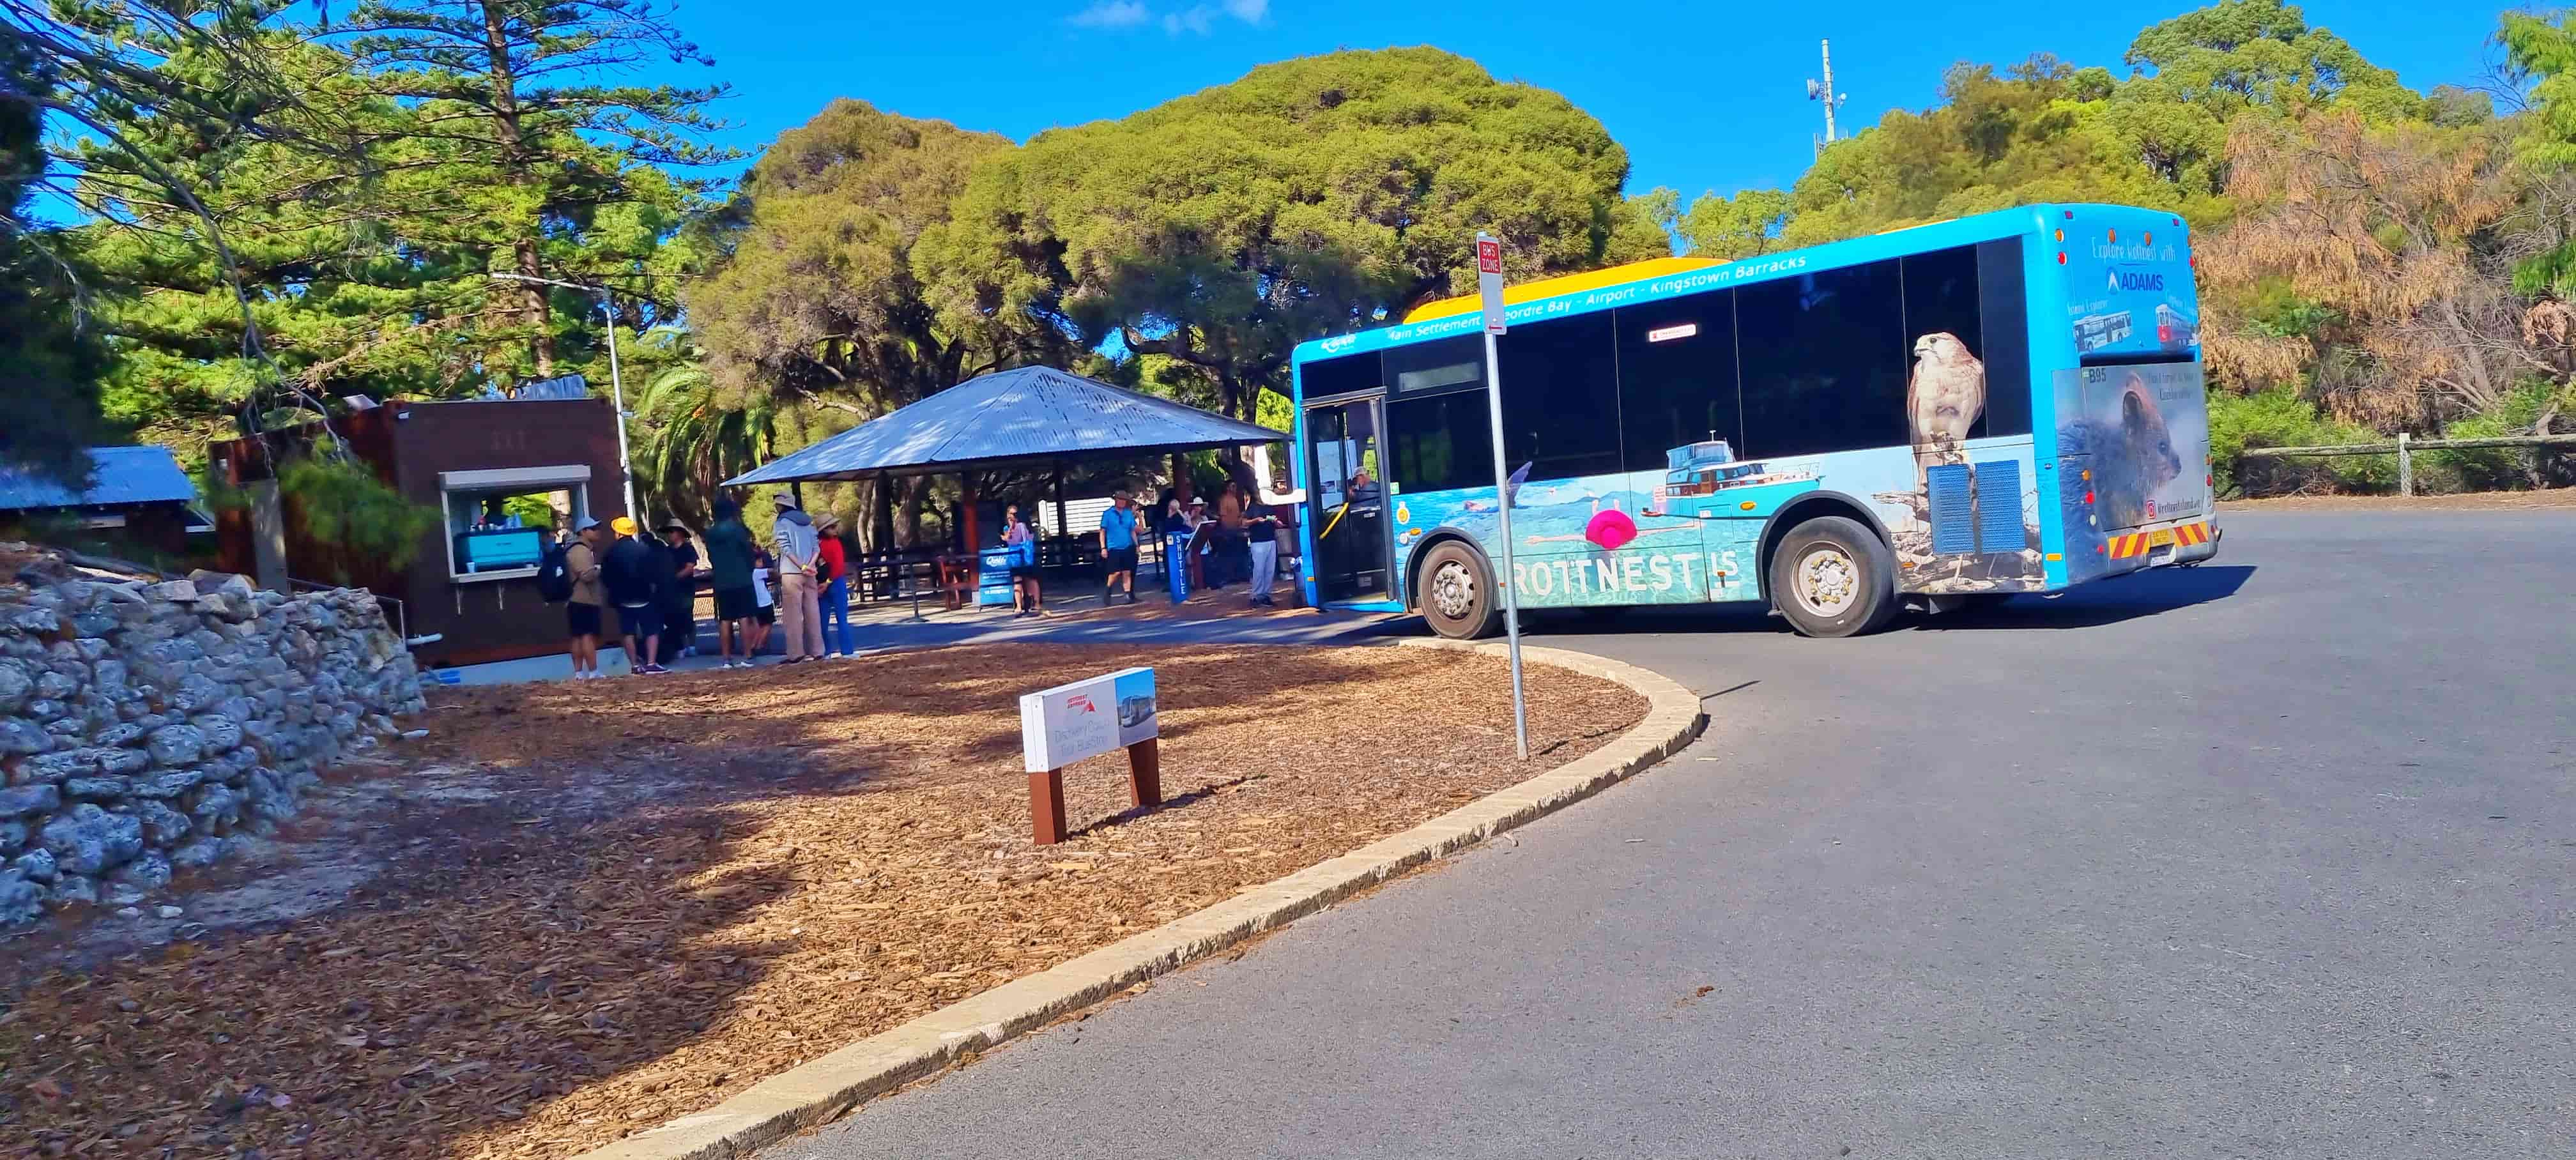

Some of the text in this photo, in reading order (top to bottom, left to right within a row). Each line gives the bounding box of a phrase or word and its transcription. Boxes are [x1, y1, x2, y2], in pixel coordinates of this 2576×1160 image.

[1482, 244, 1496, 257] BUS
[2091, 237, 2124, 263] Explore
[1482, 258, 1499, 271] ZONE
[2121, 273, 2164, 292] ADAMS
[1386, 328, 1412, 340] Main
[1415, 316, 1482, 337] Settlement
[1505, 305, 1544, 321] eordie
[1547, 299, 1572, 313] Bay
[1586, 287, 1635, 305] Airport
[1650, 271, 1730, 293] Kingstown
[1735, 256, 1806, 279] Barracks
[2089, 368, 2106, 383] B95
[1176, 535, 1186, 595] SHUTTLE
[1513, 552, 1701, 596] ROTTNEST
